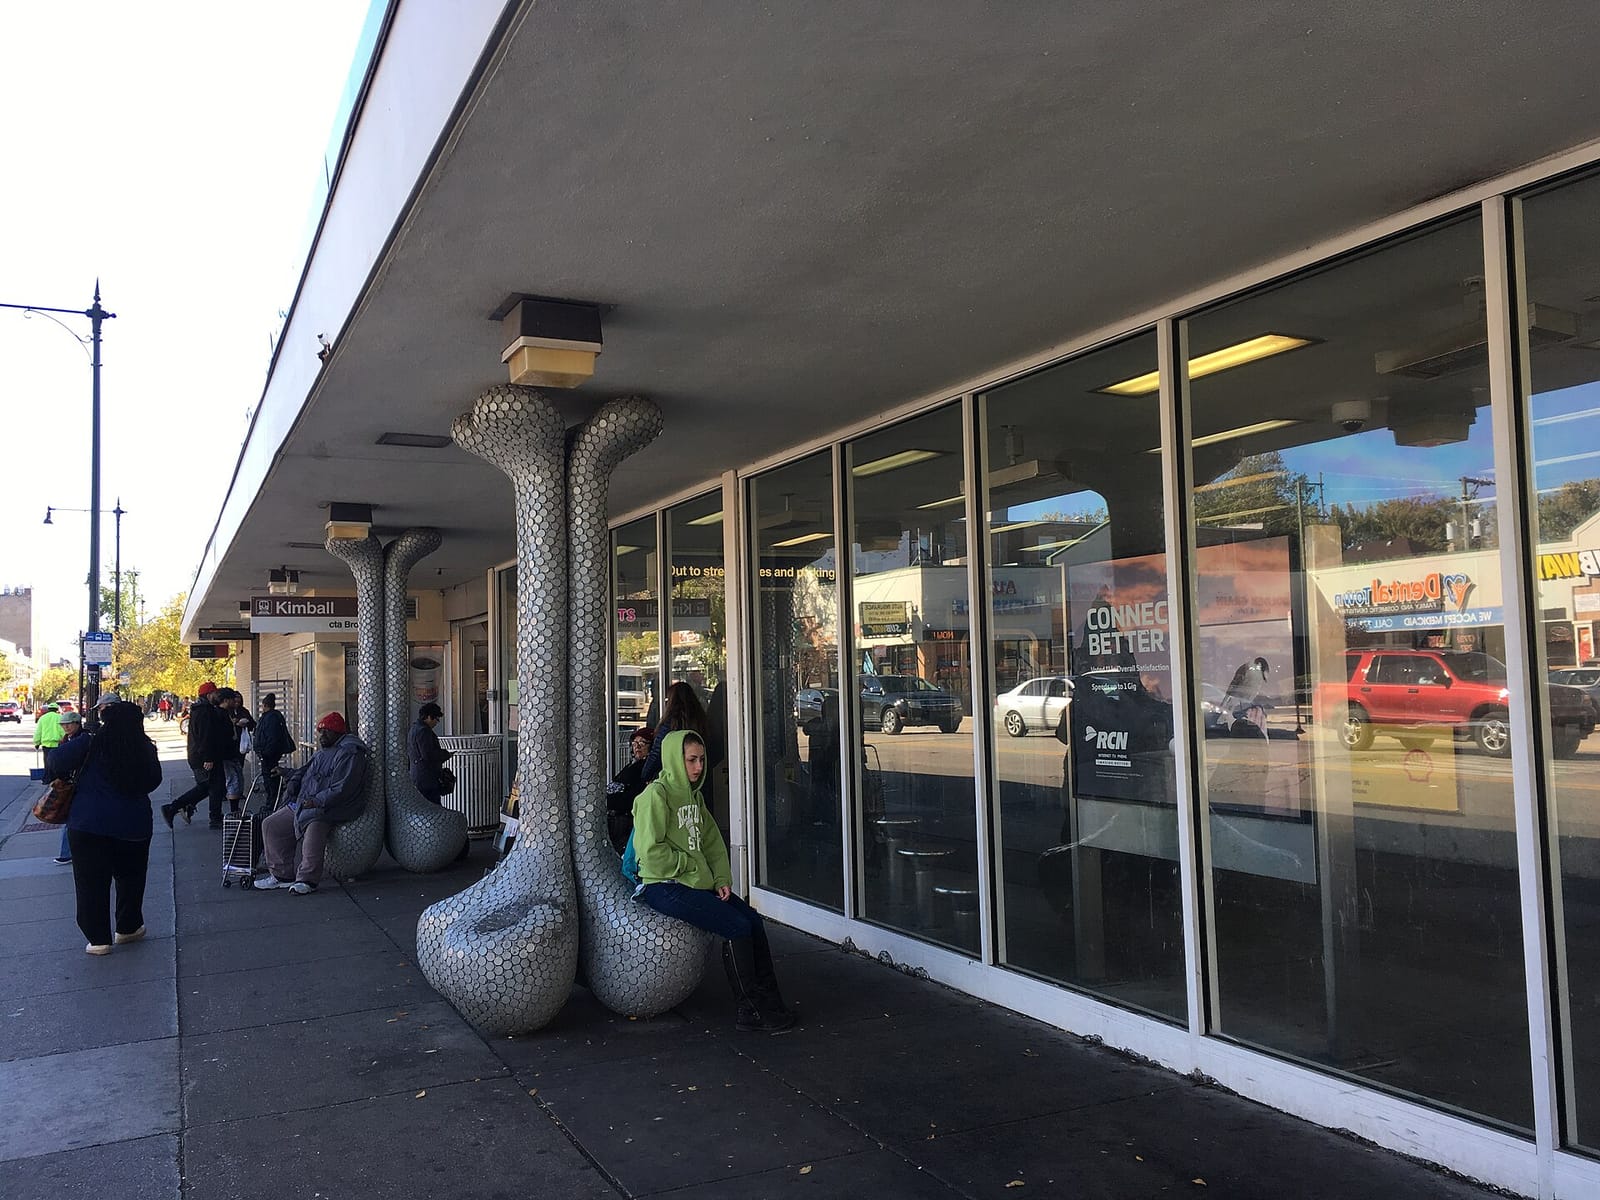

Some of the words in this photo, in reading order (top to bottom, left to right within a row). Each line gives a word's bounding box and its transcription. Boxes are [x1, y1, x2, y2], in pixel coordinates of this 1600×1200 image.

[689, 566, 700, 576] to
[703, 566, 725, 576] stre
[774, 567, 794, 577] and
[275, 601, 334, 615] Kimball
[1087, 600, 1168, 631] CONNEC
[329, 621, 343, 629] cta
[345, 621, 359, 629] Bro
[1088, 628, 1166, 656] BETTER
[1136, 663, 1169, 672] Satisfaction
[1127, 682, 1137, 692] Gig
[1096, 731, 1129, 750] RCN
